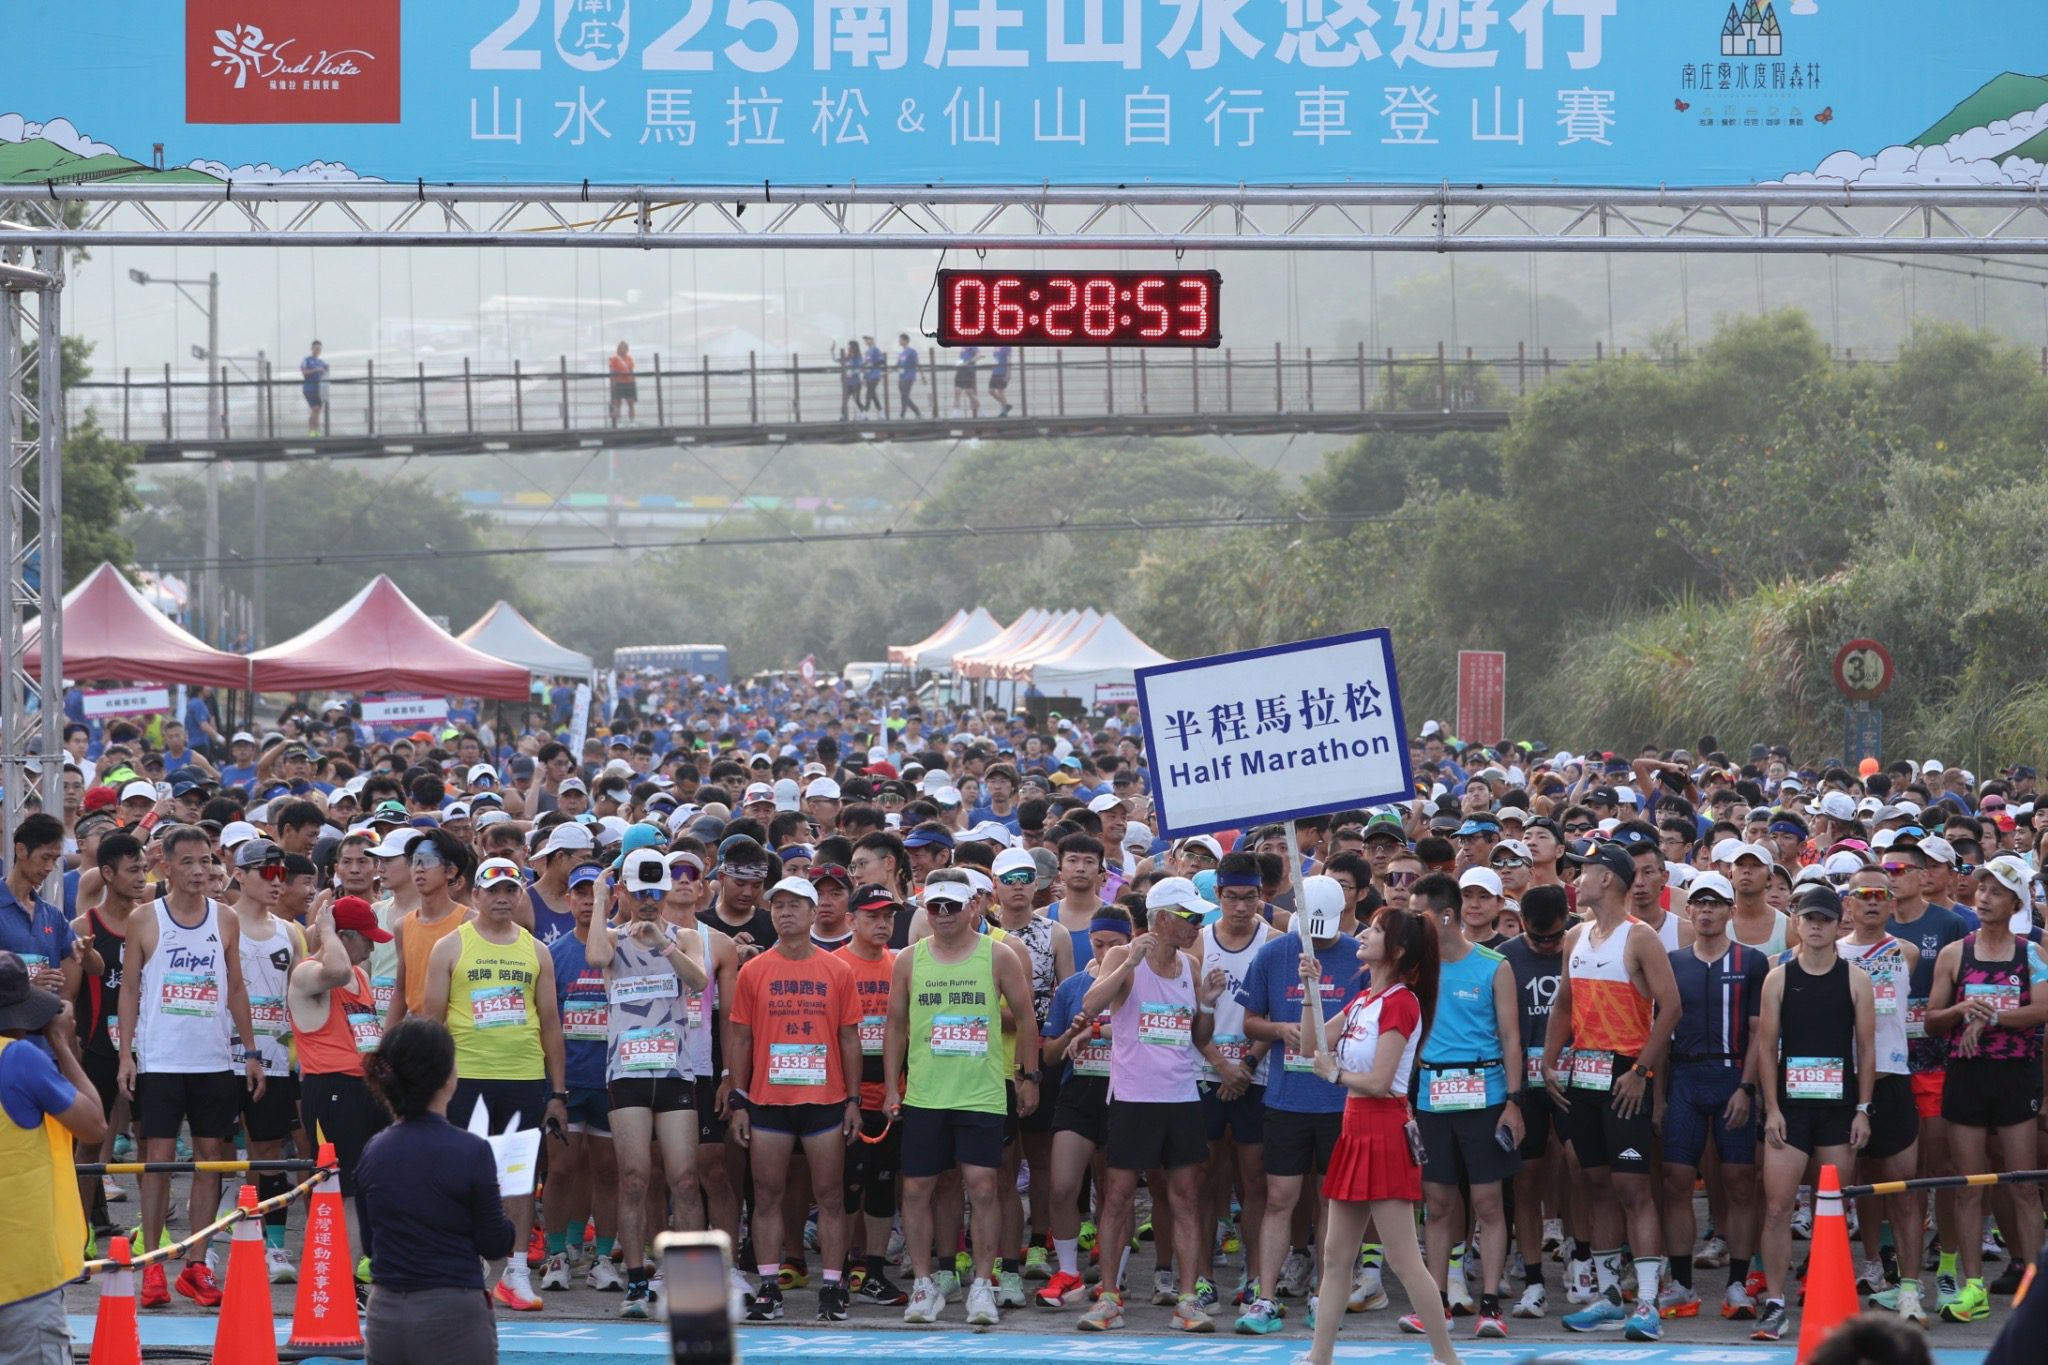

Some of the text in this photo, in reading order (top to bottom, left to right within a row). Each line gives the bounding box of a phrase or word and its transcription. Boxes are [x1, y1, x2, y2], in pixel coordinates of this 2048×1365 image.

[261, 38, 312, 77] Sud
[1682, 62, 1821, 90] 南庄雲水度假森林
[954, 279, 1208, 337] 06:28:53
[1164, 680, 1383, 751] 半程馬拉松
[1169, 735, 1390, 787] Half Marathon
[166, 946, 216, 972] Taipei
[500, 959, 527, 967] Runner
[467, 969, 492, 981] 視障
[769, 980, 827, 997] 視障跑者
[950, 979, 977, 987] Runner
[164, 985, 203, 1000] 1357
[918, 991, 986, 1006] 視障 陪跑員
[474, 998, 512, 1013] 1543
[565, 1012, 600, 1024] 1071
[1141, 1015, 1177, 1029] 1456
[933, 1027, 971, 1040] 2153
[622, 1040, 659, 1054] 1593
[771, 1056, 809, 1068] 1538
[1788, 1069, 1826, 1082] 2198
[1432, 1081, 1469, 1094] 1282
[312, 1203, 333, 1318] 台灣運動賽事協會
